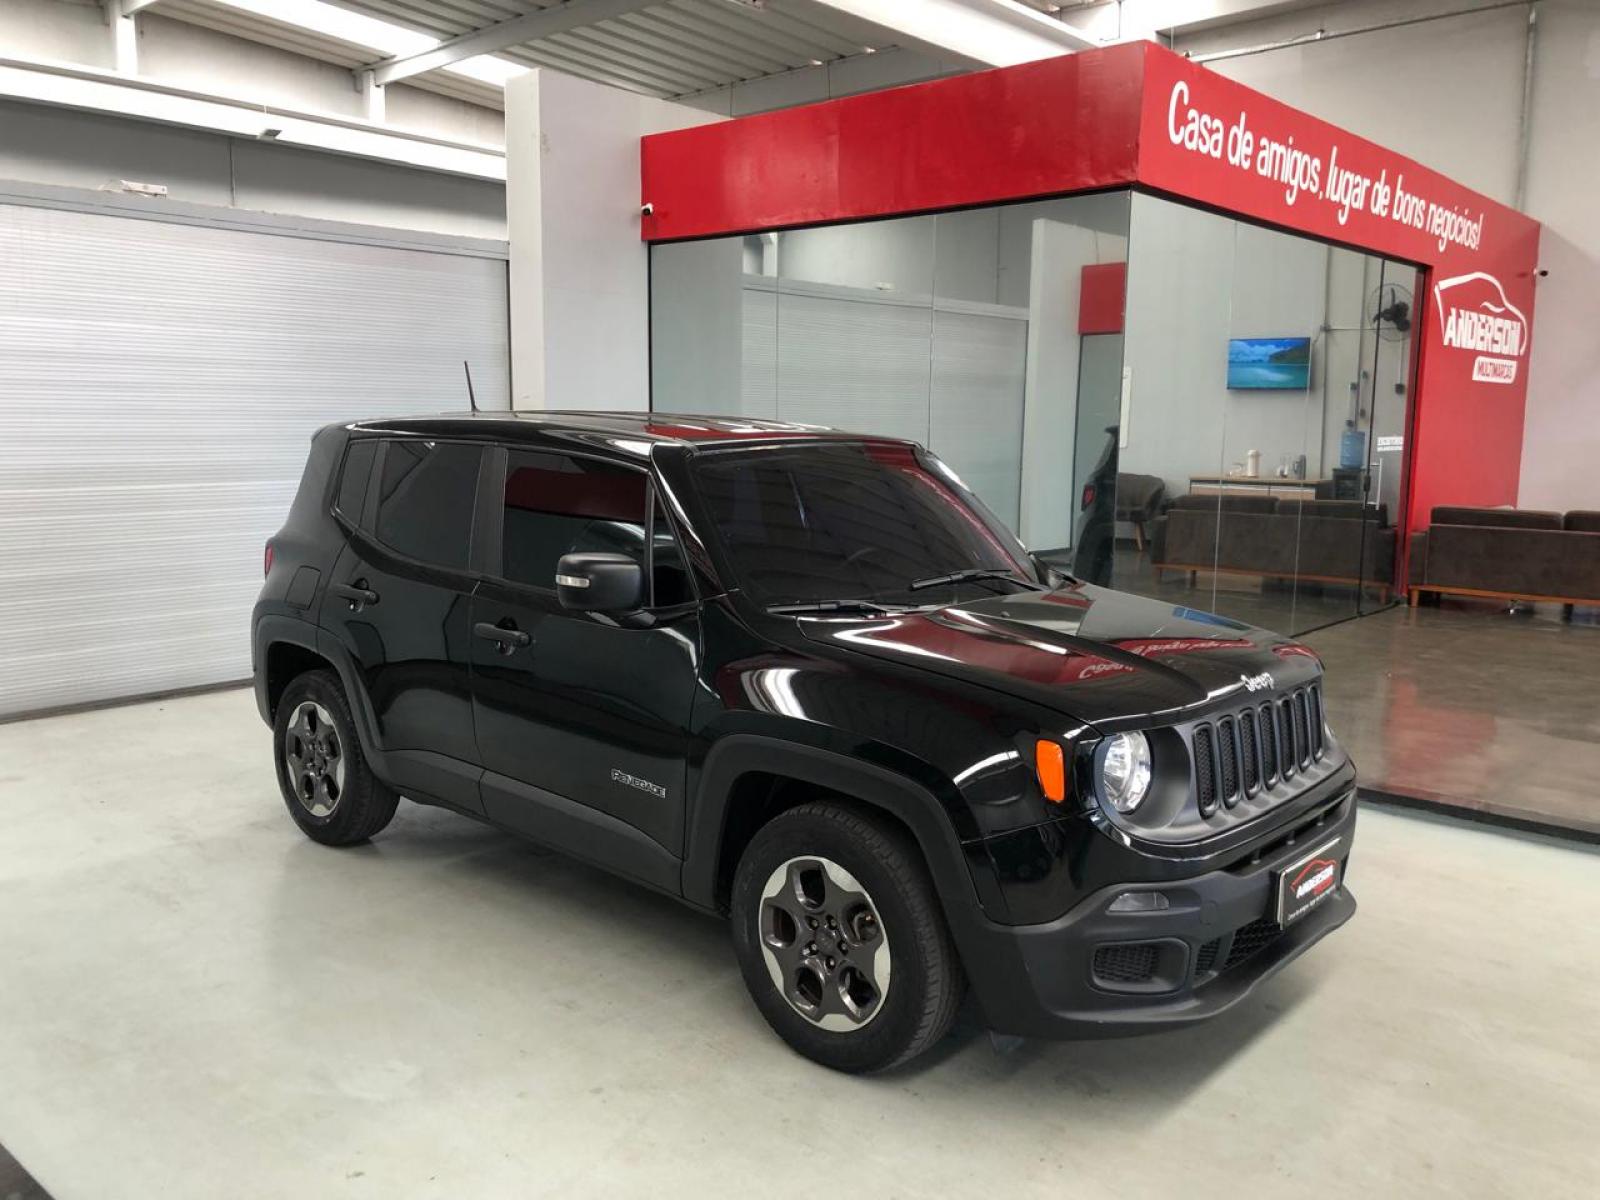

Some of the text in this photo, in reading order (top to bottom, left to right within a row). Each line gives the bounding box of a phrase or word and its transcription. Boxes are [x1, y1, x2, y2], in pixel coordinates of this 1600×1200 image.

[1168, 80, 1484, 253] Casa de amigos, lugar de bons negócios!
[1443, 306, 1521, 356] ANDERSON
[1240, 672, 1275, 692] Jeep
